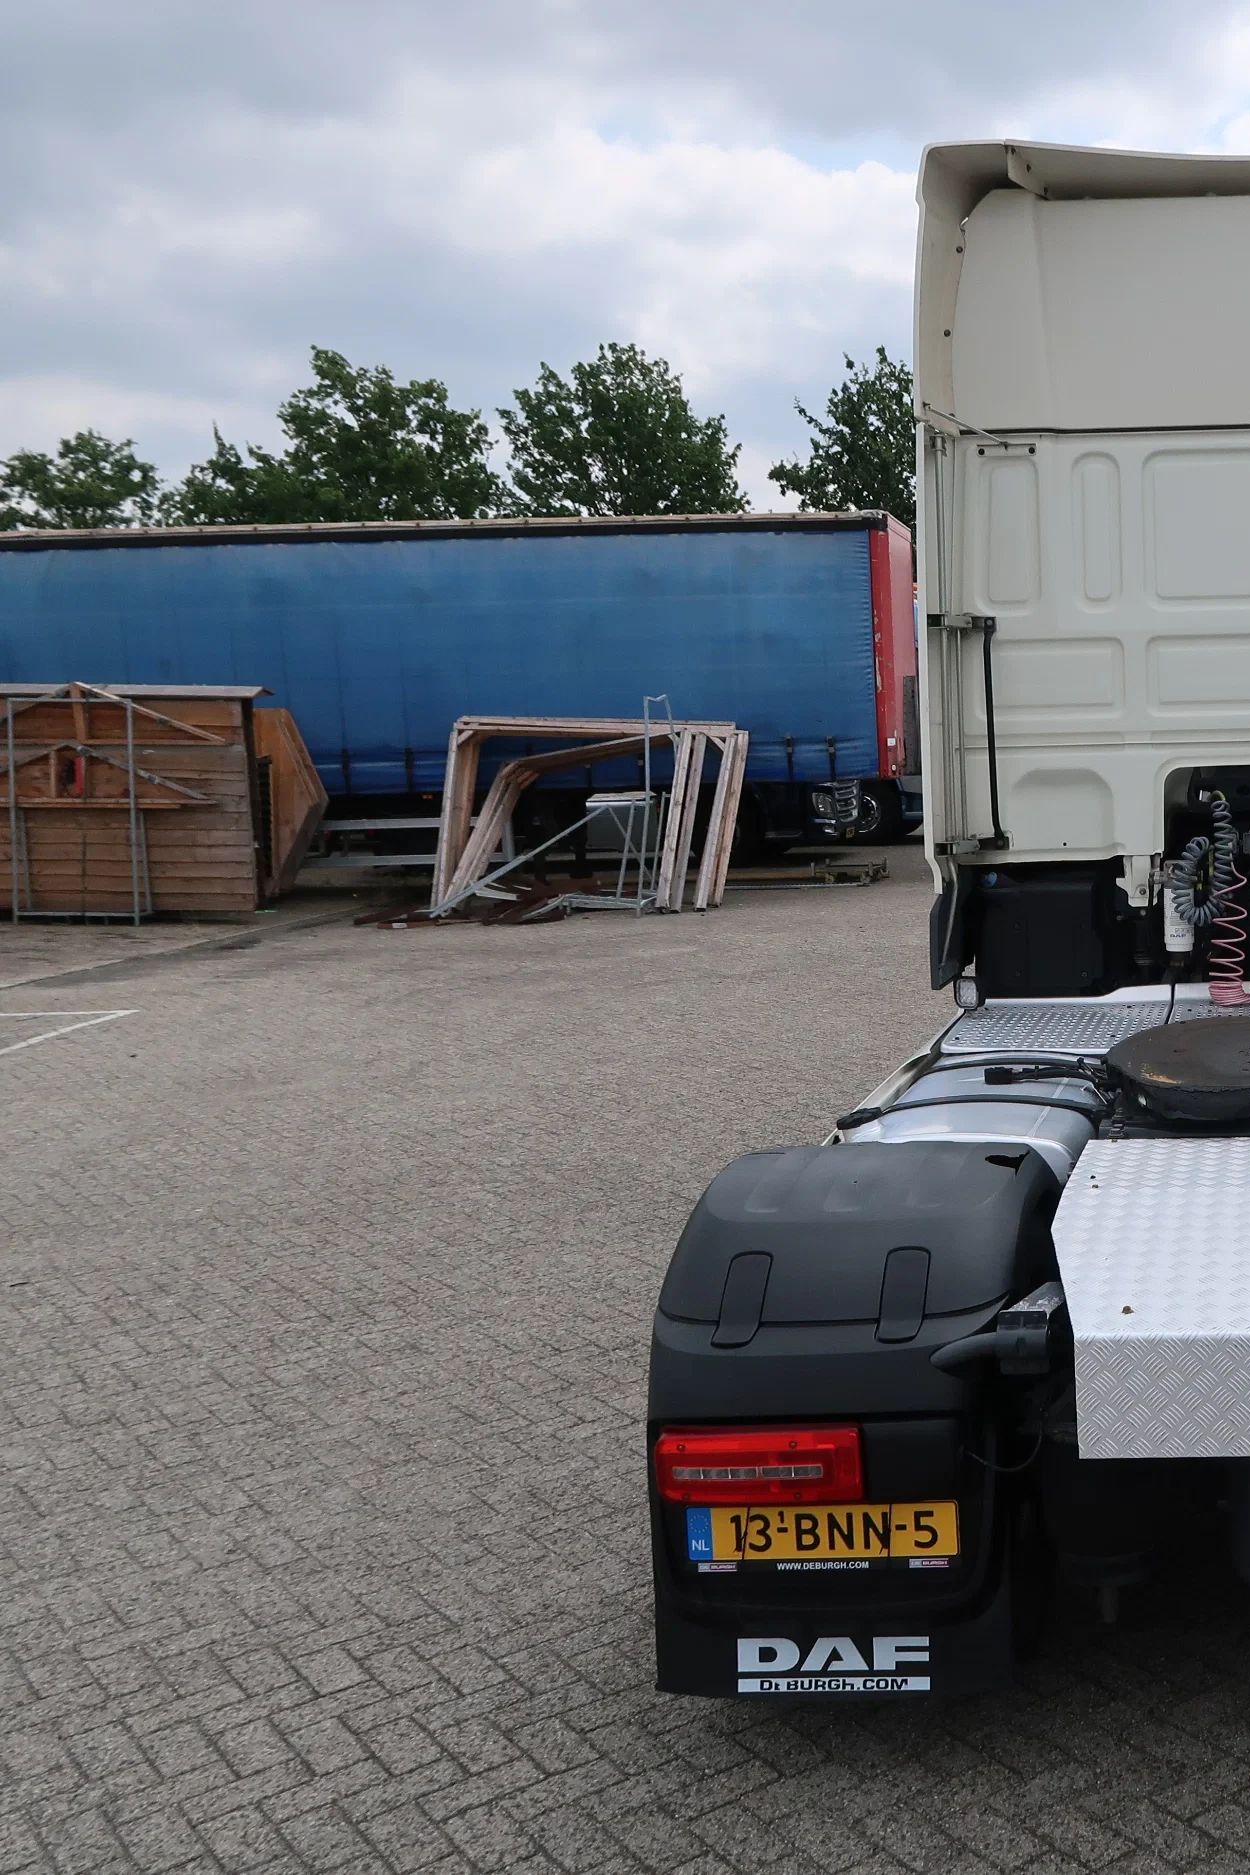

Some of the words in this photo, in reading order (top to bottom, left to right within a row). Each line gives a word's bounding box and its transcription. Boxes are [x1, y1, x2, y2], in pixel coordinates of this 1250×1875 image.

[729, 1510, 938, 1553] 13-BNN-5
[691, 1539, 710, 1551] NL
[776, 1560, 869, 1571] WWW.DEBURGH.COM
[737, 1636, 930, 1673] DAF
